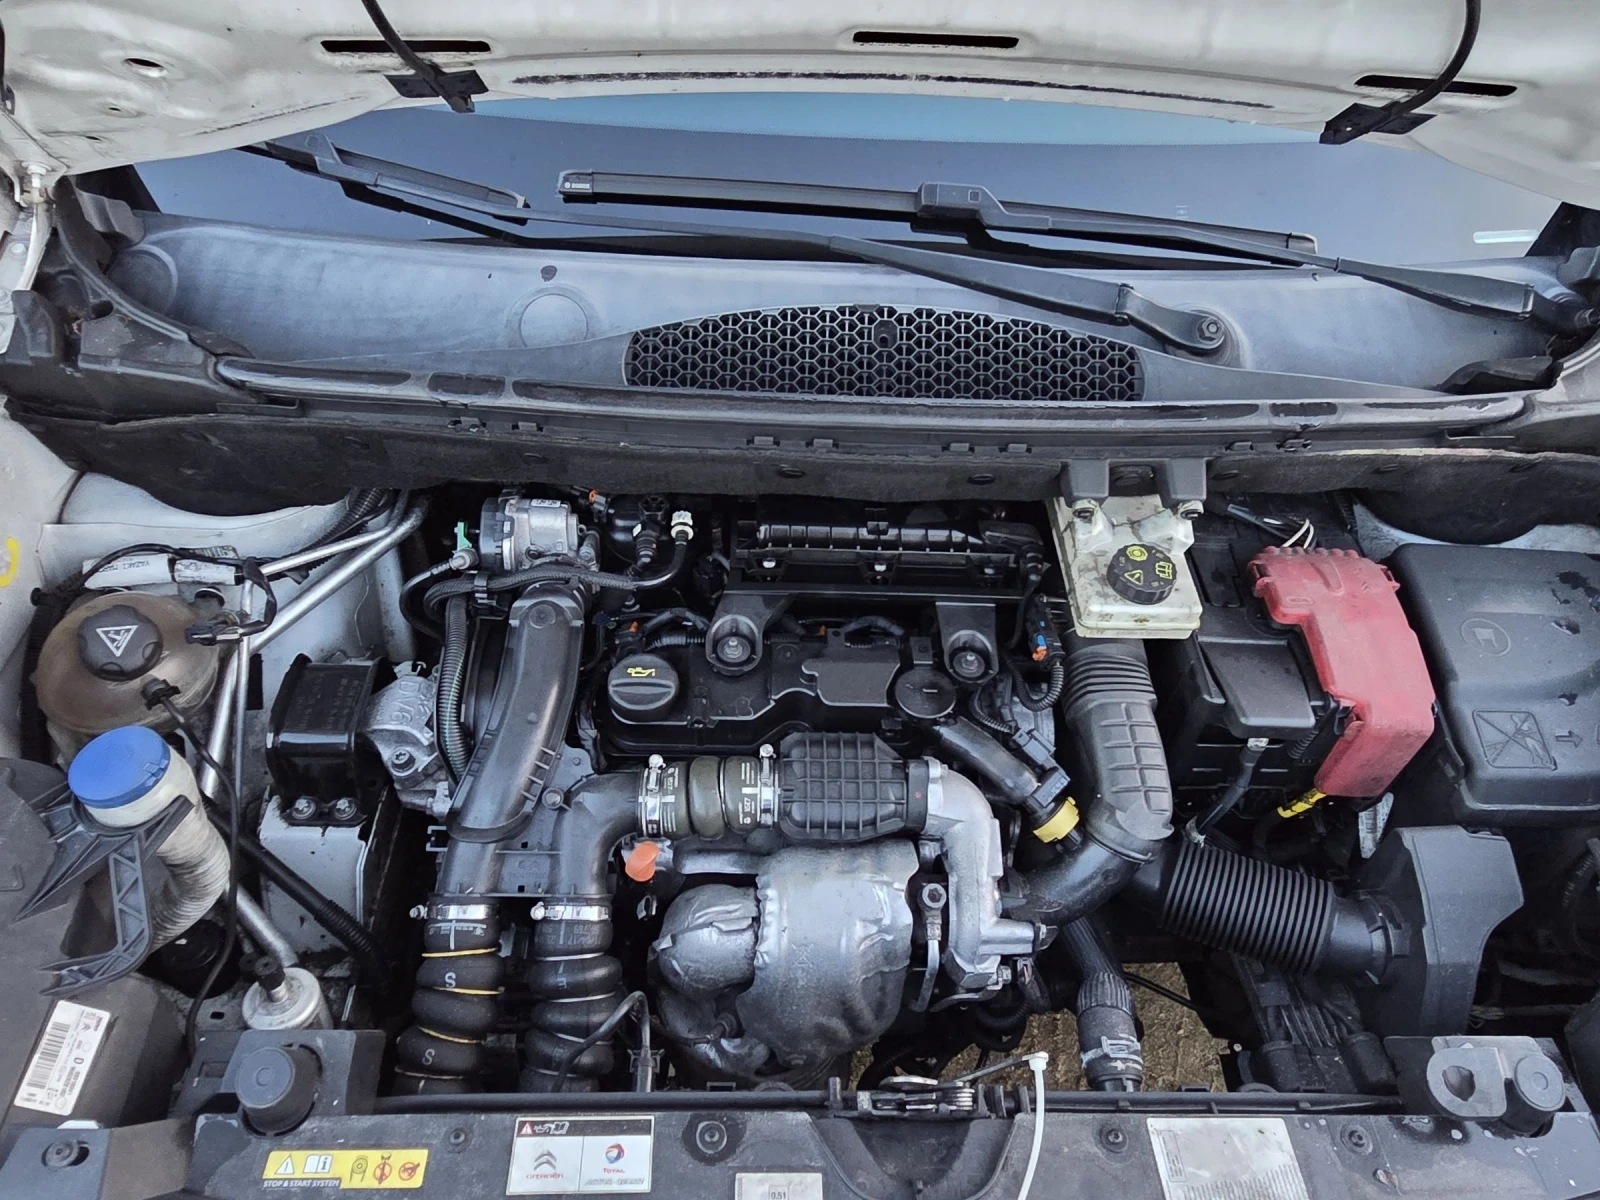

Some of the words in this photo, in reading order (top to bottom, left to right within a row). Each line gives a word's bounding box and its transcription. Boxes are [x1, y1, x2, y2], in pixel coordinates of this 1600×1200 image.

[122, 561, 150, 570] YAZAKI
[444, 972, 457, 988] S
[422, 1048, 436, 1066] S
[263, 1180, 283, 1188] STOP
[289, 1180, 312, 1188] START
[312, 1180, 340, 1188] SYSTEM
[770, 1191, 787, 1200] 0.51
